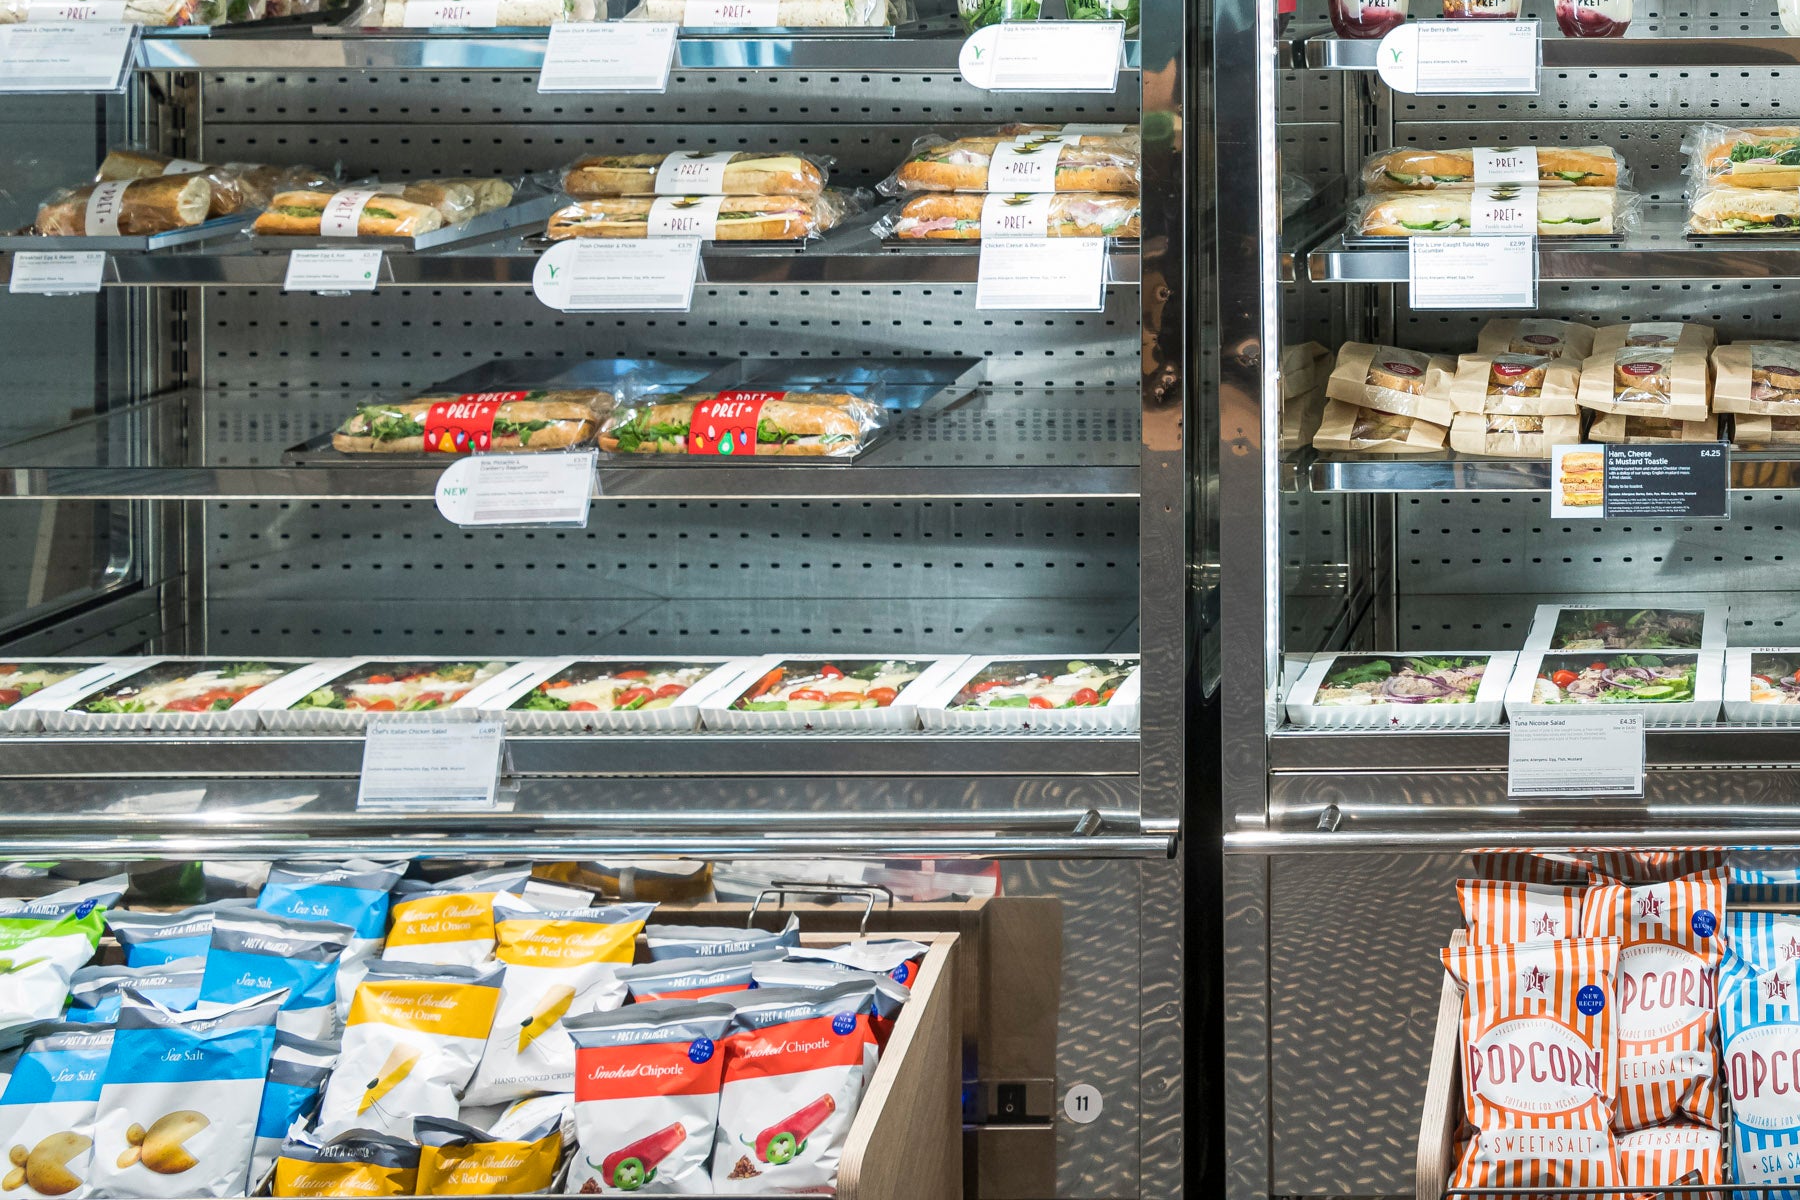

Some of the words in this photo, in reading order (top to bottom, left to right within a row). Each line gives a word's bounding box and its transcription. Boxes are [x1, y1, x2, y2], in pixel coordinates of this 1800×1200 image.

[442, 6, 463, 19] PRET
[680, 164, 704, 176] PRET
[1003, 216, 1026, 229] PRET
[1494, 209, 1516, 221] PRET
[447, 401, 483, 419] PRET
[712, 400, 746, 418] PRET
[1608, 450, 1626, 458] Ham,
[1627, 450, 1652, 458] Cheese
[443, 486, 468, 496] NEW
[287, 900, 309, 916] Sea
[311, 904, 330, 917] Salt
[1638, 898, 1665, 917] PRET
[406, 925, 416, 935] &
[420, 923, 439, 933] Red
[441, 921, 471, 932] Onion
[236, 971, 256, 987] Sea
[256, 976, 272, 989] Salt
[1621, 967, 1714, 1015] PCORN
[1578, 999, 1605, 1007] RECIPE
[161, 1047, 183, 1062] Sea
[184, 1049, 205, 1061] Salt
[743, 1039, 785, 1059] Smoked
[786, 1038, 830, 1053] Chipotle
[52, 1067, 77, 1082] Sea
[77, 1070, 97, 1081] Salt
[588, 1062, 638, 1080] Smoked
[639, 1063, 684, 1077] Chipotle
[1469, 1041, 1601, 1094] POPCORN
[1075, 1095, 1089, 1111] 11
[1762, 1153, 1787, 1174] SEA
